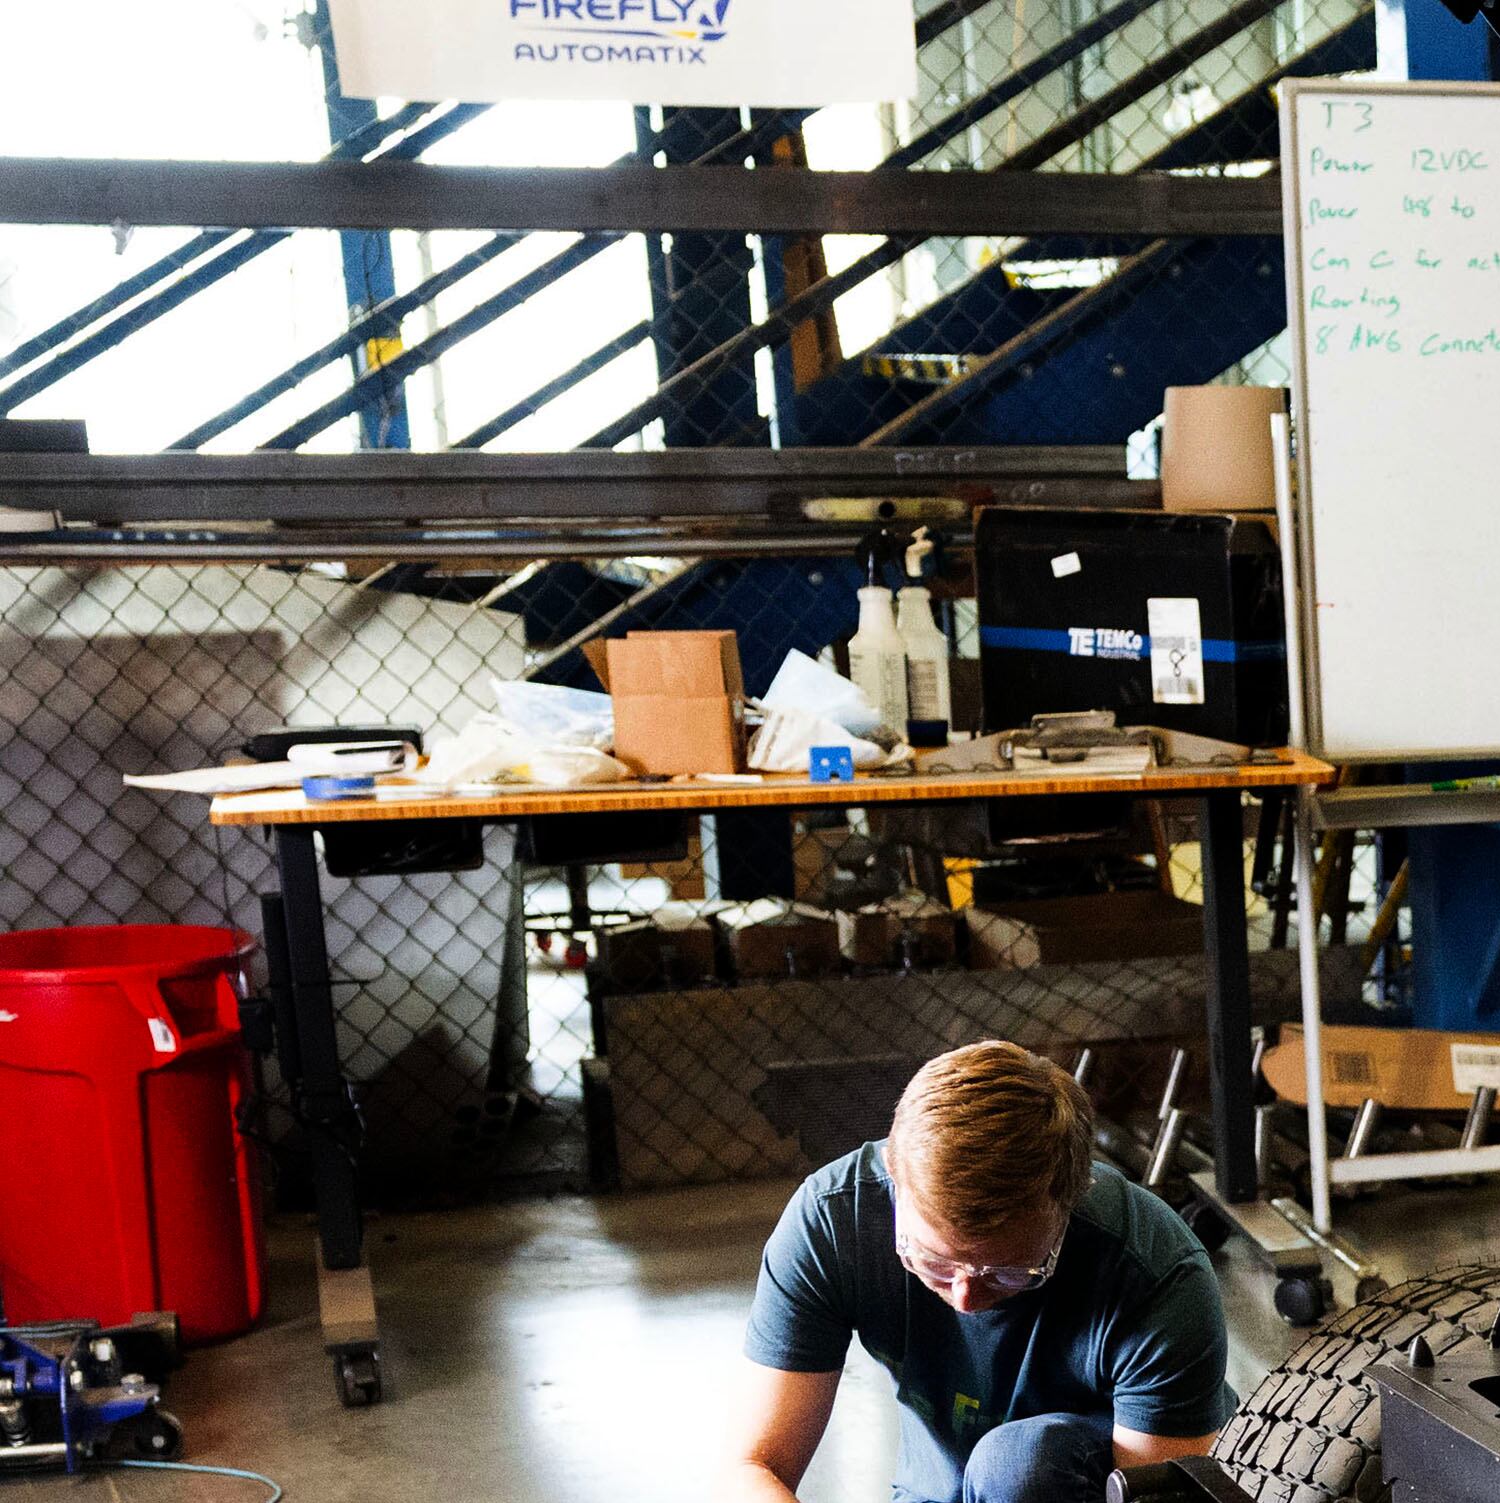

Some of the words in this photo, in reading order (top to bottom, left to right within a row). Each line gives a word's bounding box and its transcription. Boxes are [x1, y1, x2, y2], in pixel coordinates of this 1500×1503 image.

[509, 0, 695, 22] FIREFLY
[514, 43, 706, 65] AUTOMATIX
[1310, 146, 1375, 177] Power
[1410, 148, 1489, 172] 12VDC
[1309, 198, 1359, 226] Power
[1451, 196, 1477, 220] to
